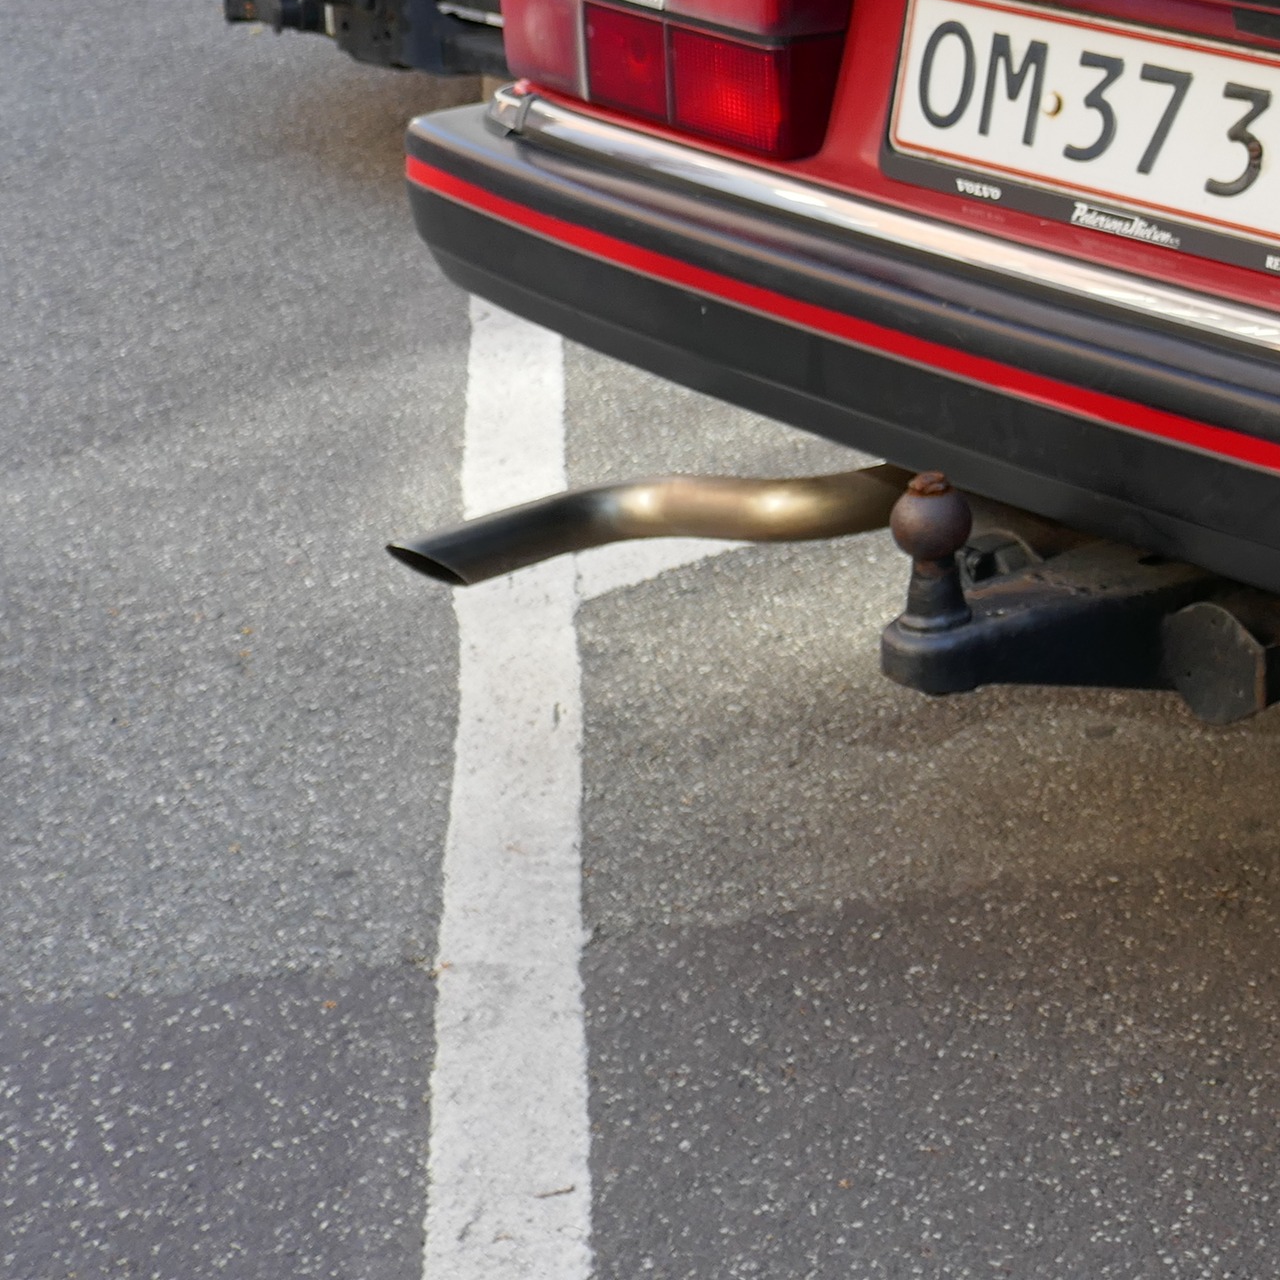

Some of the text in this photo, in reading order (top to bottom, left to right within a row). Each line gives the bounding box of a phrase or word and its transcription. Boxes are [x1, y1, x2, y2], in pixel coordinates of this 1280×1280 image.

[919, 20, 1048, 147] OM
[1063, 50, 1193, 174] 37
[955, 178, 1002, 200] VOLVO
